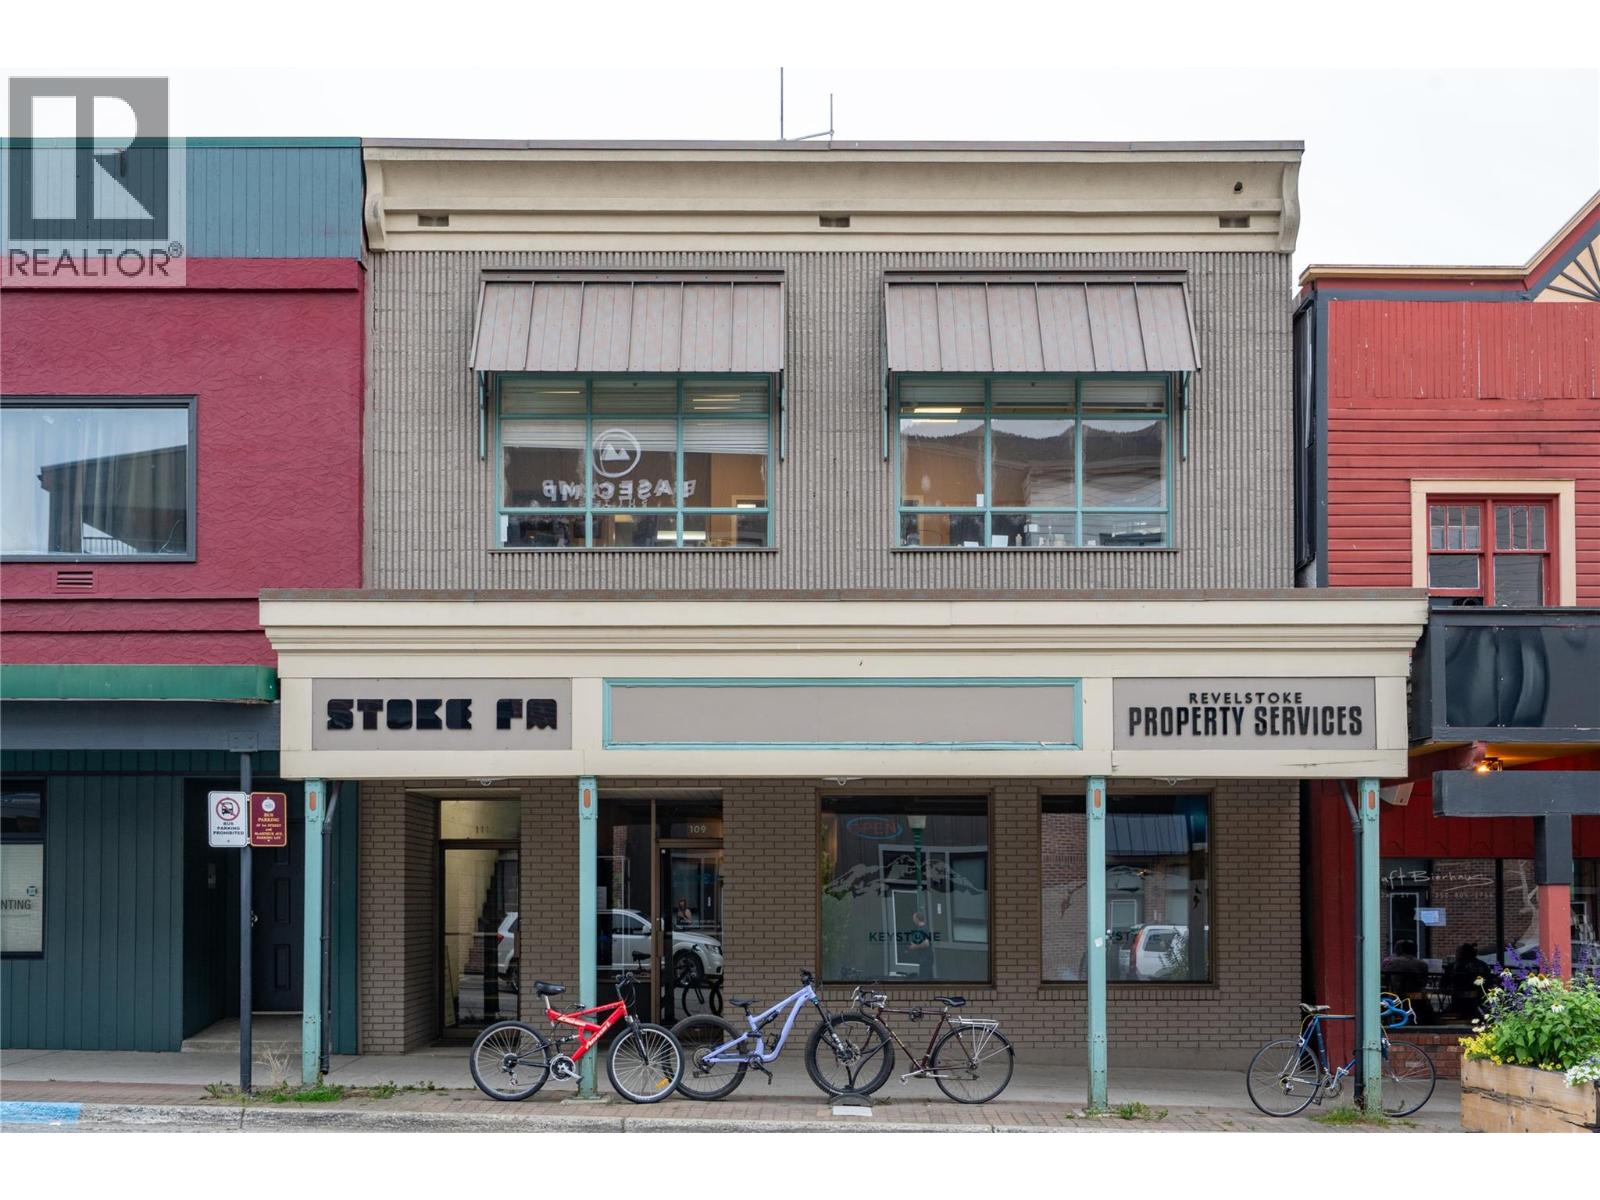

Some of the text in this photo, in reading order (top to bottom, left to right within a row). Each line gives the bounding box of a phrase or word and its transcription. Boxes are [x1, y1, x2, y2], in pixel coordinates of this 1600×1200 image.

[1189, 692, 1303, 704] REVELSTOKE
[327, 699, 558, 730] STOKE FM
[1128, 705, 1362, 736] PROPERTY SERVICES
[689, 824, 706, 834] 109
